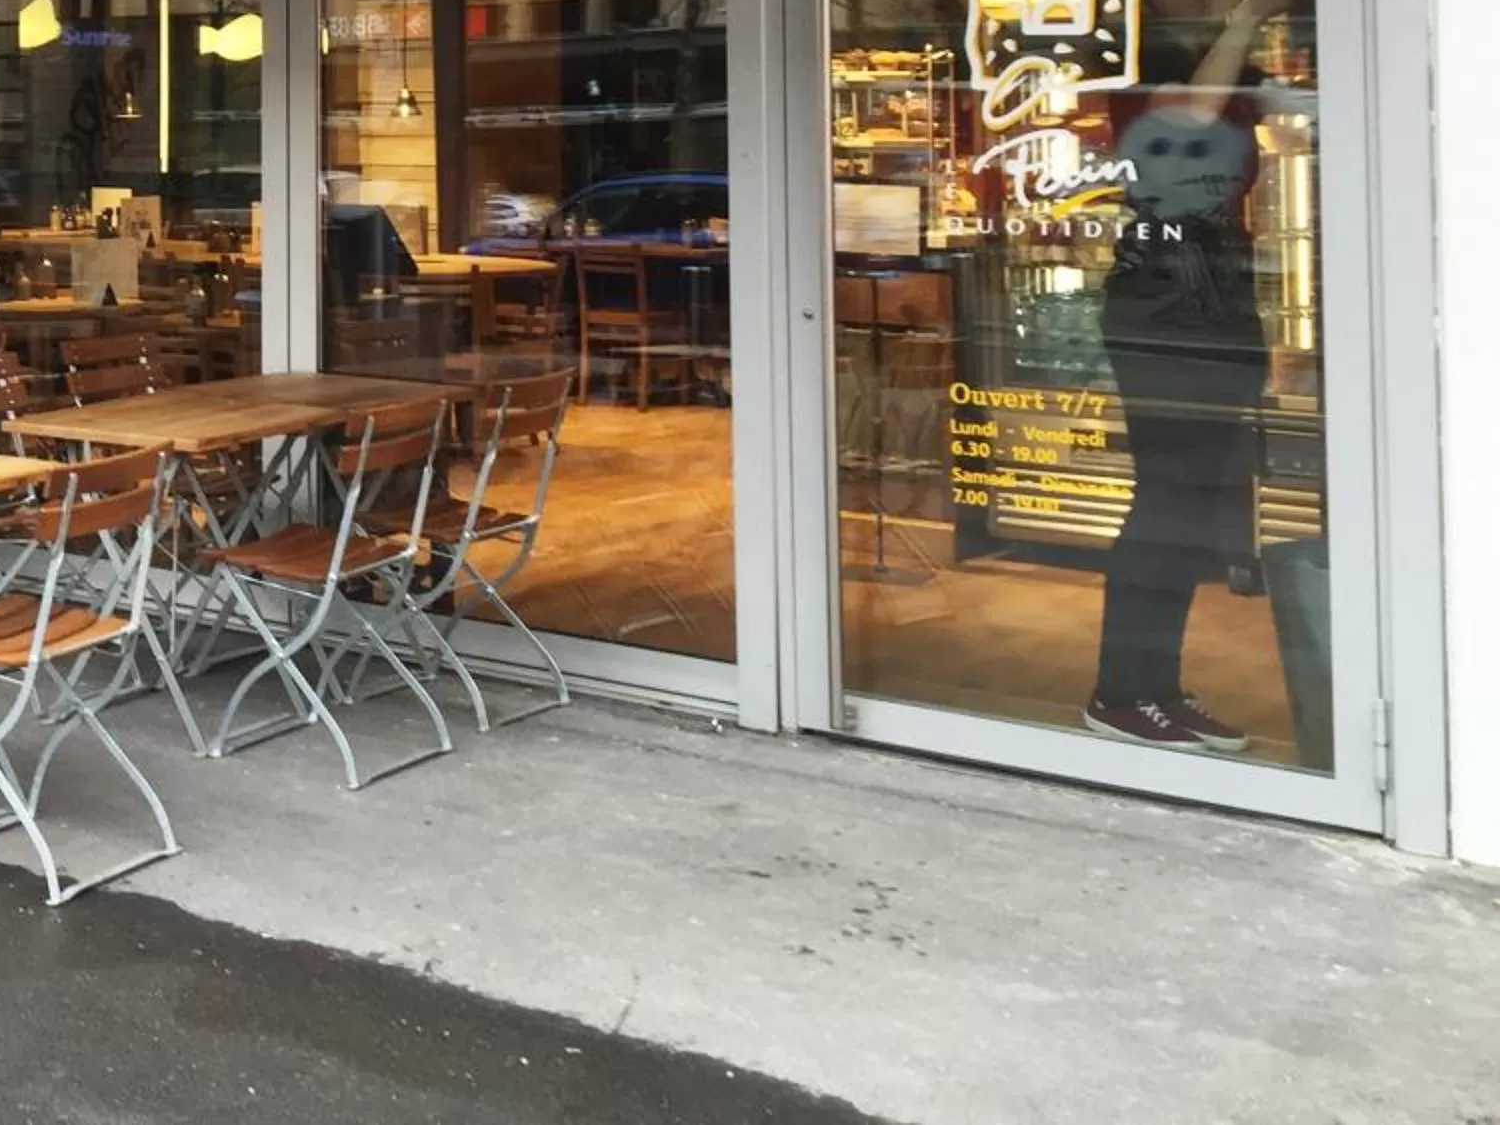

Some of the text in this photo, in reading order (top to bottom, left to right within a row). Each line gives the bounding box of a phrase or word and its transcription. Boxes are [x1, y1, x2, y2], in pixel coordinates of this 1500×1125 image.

[946, 217, 1184, 242] QUOTIDIEN
[949, 382, 1107, 416] Ouvert 7/7
[950, 418, 998, 437] Lundi
[1023, 426, 1107, 448] Vendredi
[951, 440, 991, 457] 6.30
[953, 488, 988, 507] 7.00
